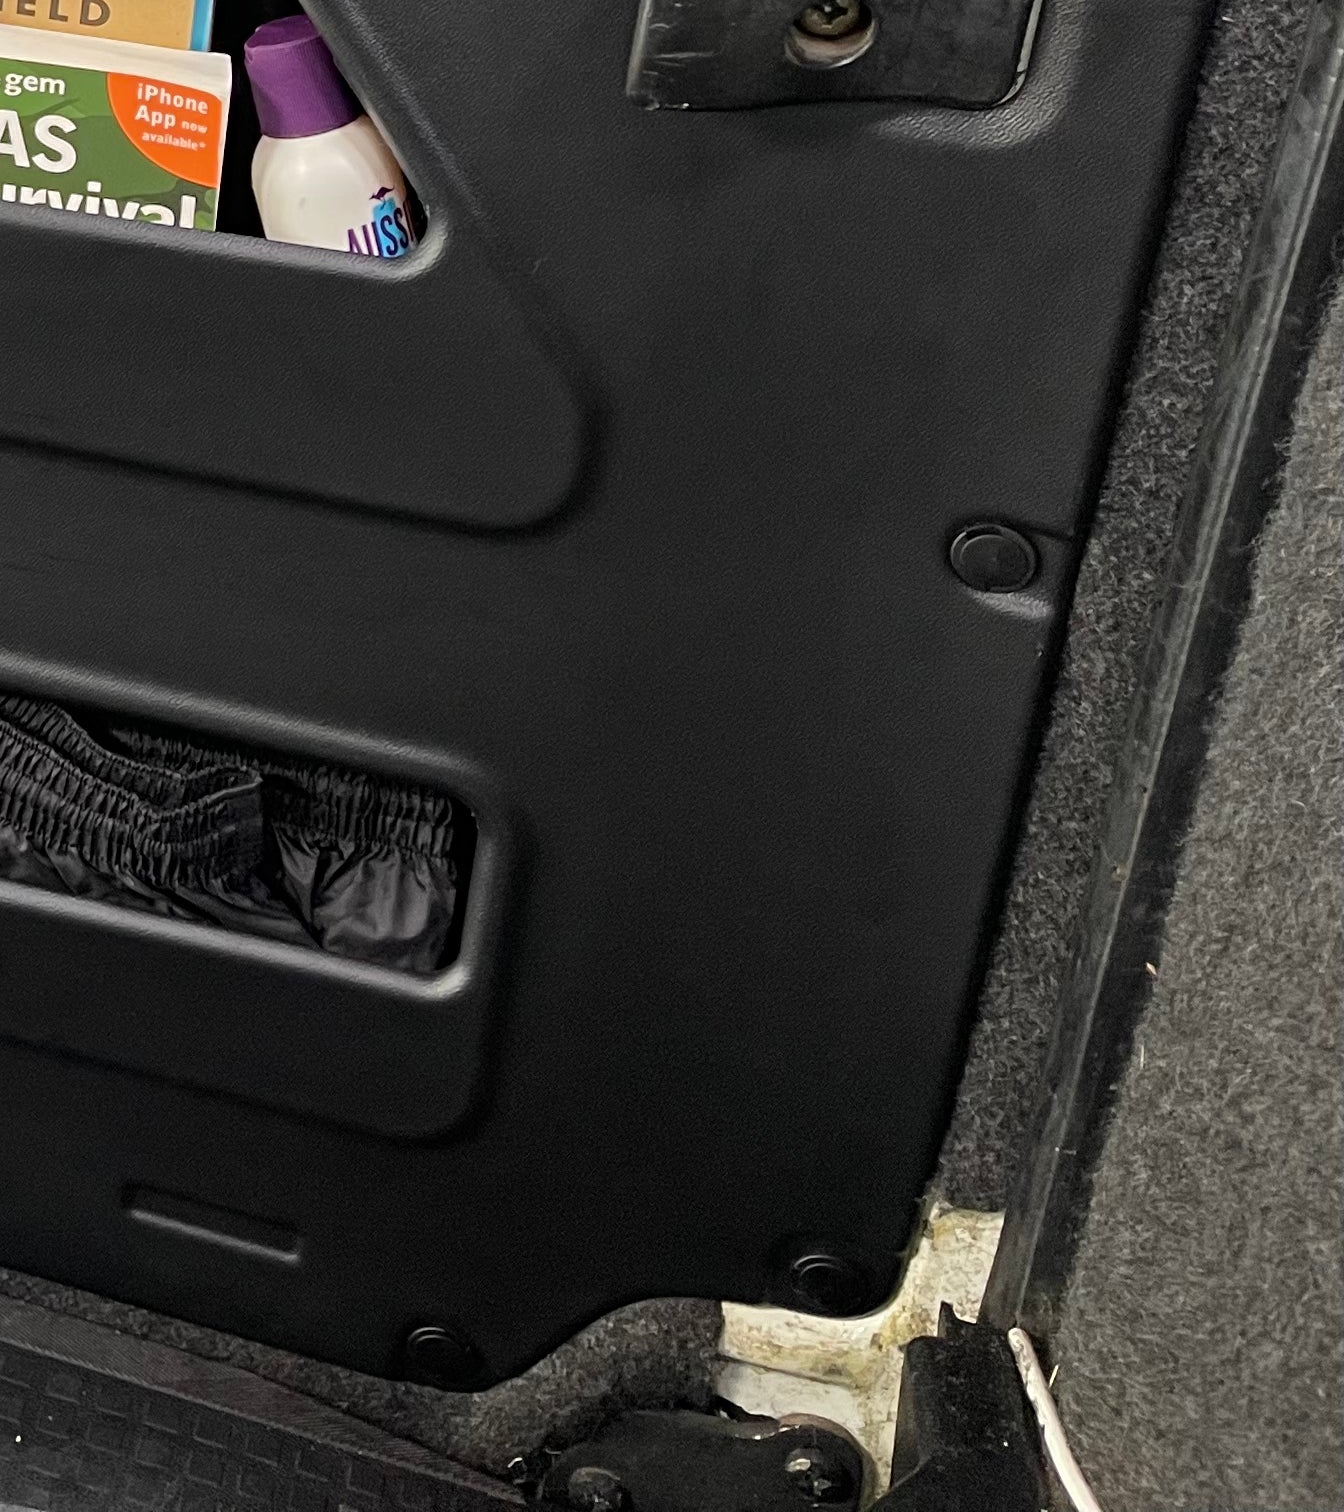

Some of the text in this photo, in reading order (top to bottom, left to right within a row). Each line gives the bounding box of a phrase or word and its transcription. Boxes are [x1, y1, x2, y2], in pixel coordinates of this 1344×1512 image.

[4, 72, 66, 97] gem
[137, 82, 209, 115] iPhone
[135, 105, 208, 134] App now
